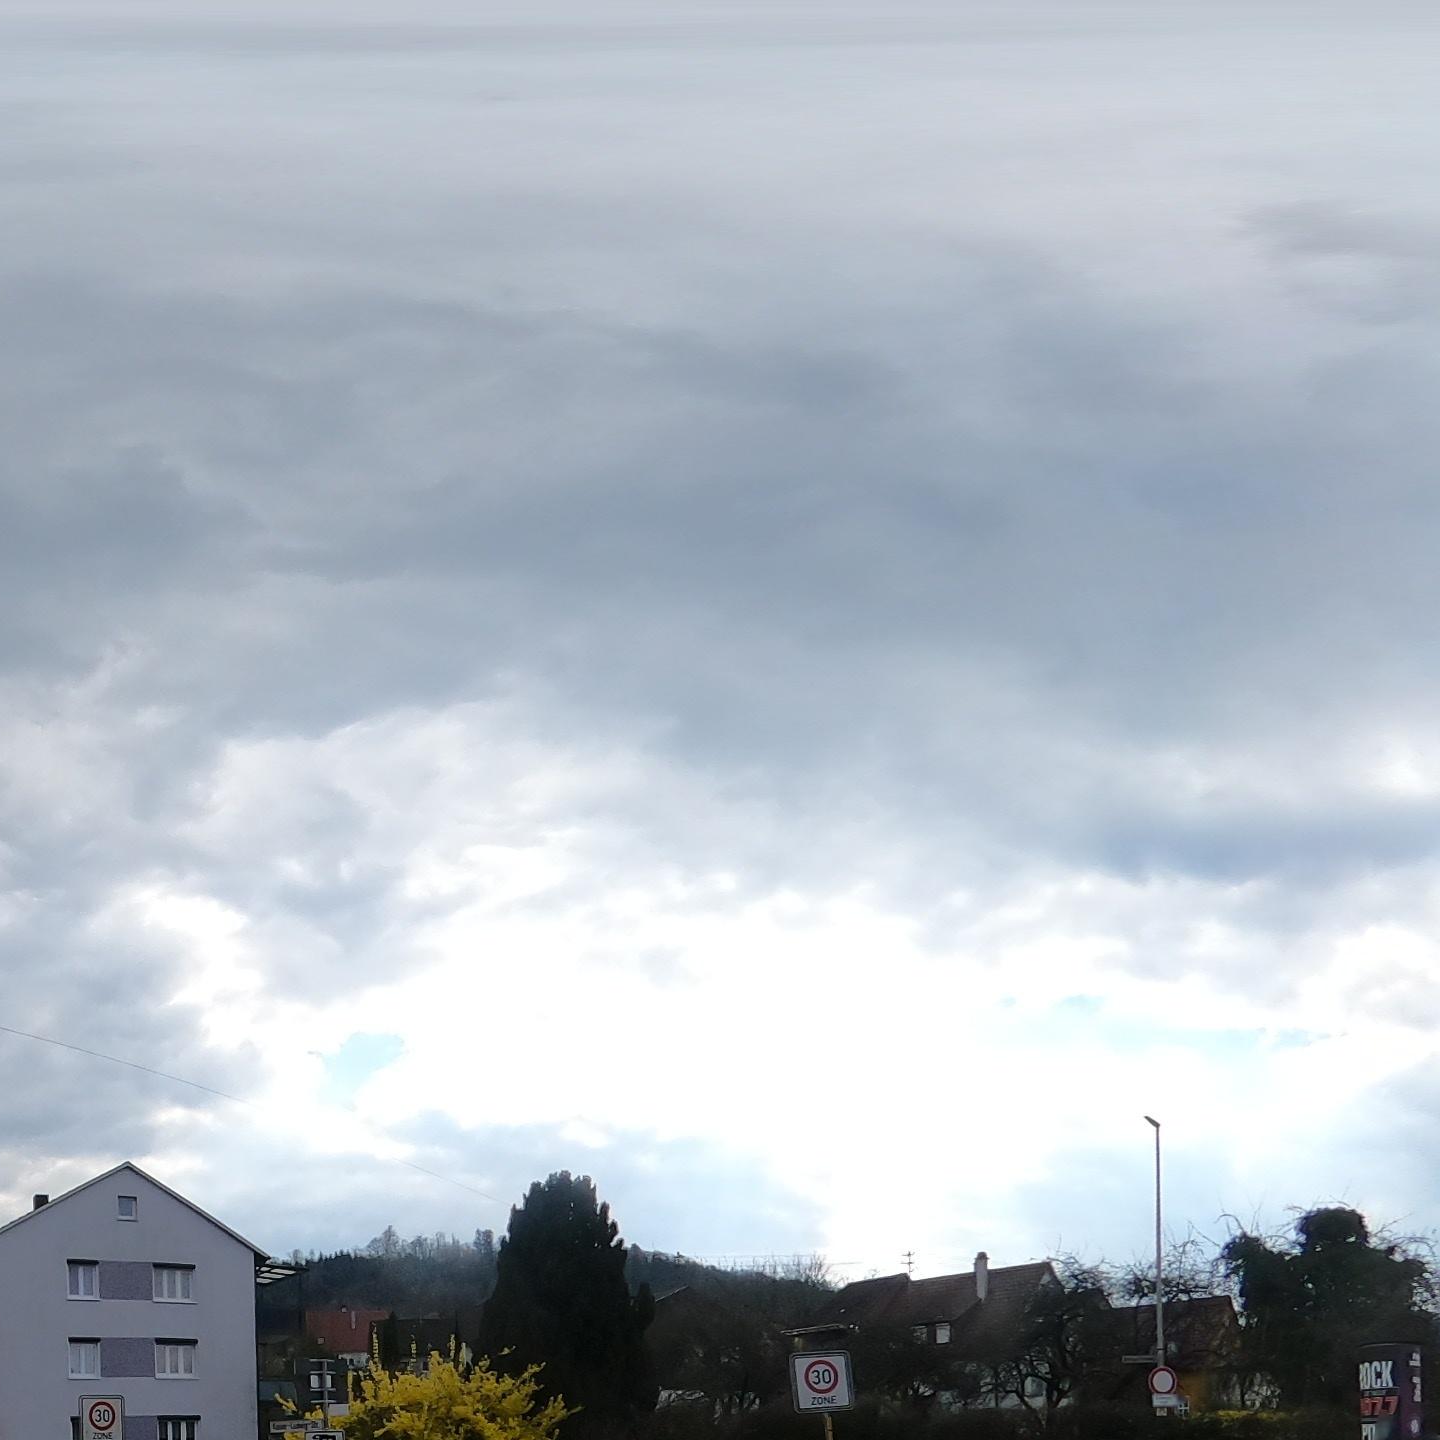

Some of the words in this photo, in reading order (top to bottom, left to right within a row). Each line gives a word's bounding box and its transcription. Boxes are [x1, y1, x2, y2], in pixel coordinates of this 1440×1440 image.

[811, 1368, 832, 1385] 30
[811, 1395, 837, 1406] ZONE
[94, 1408, 110, 1423] 30
[92, 1431, 113, 1440] ZONE
